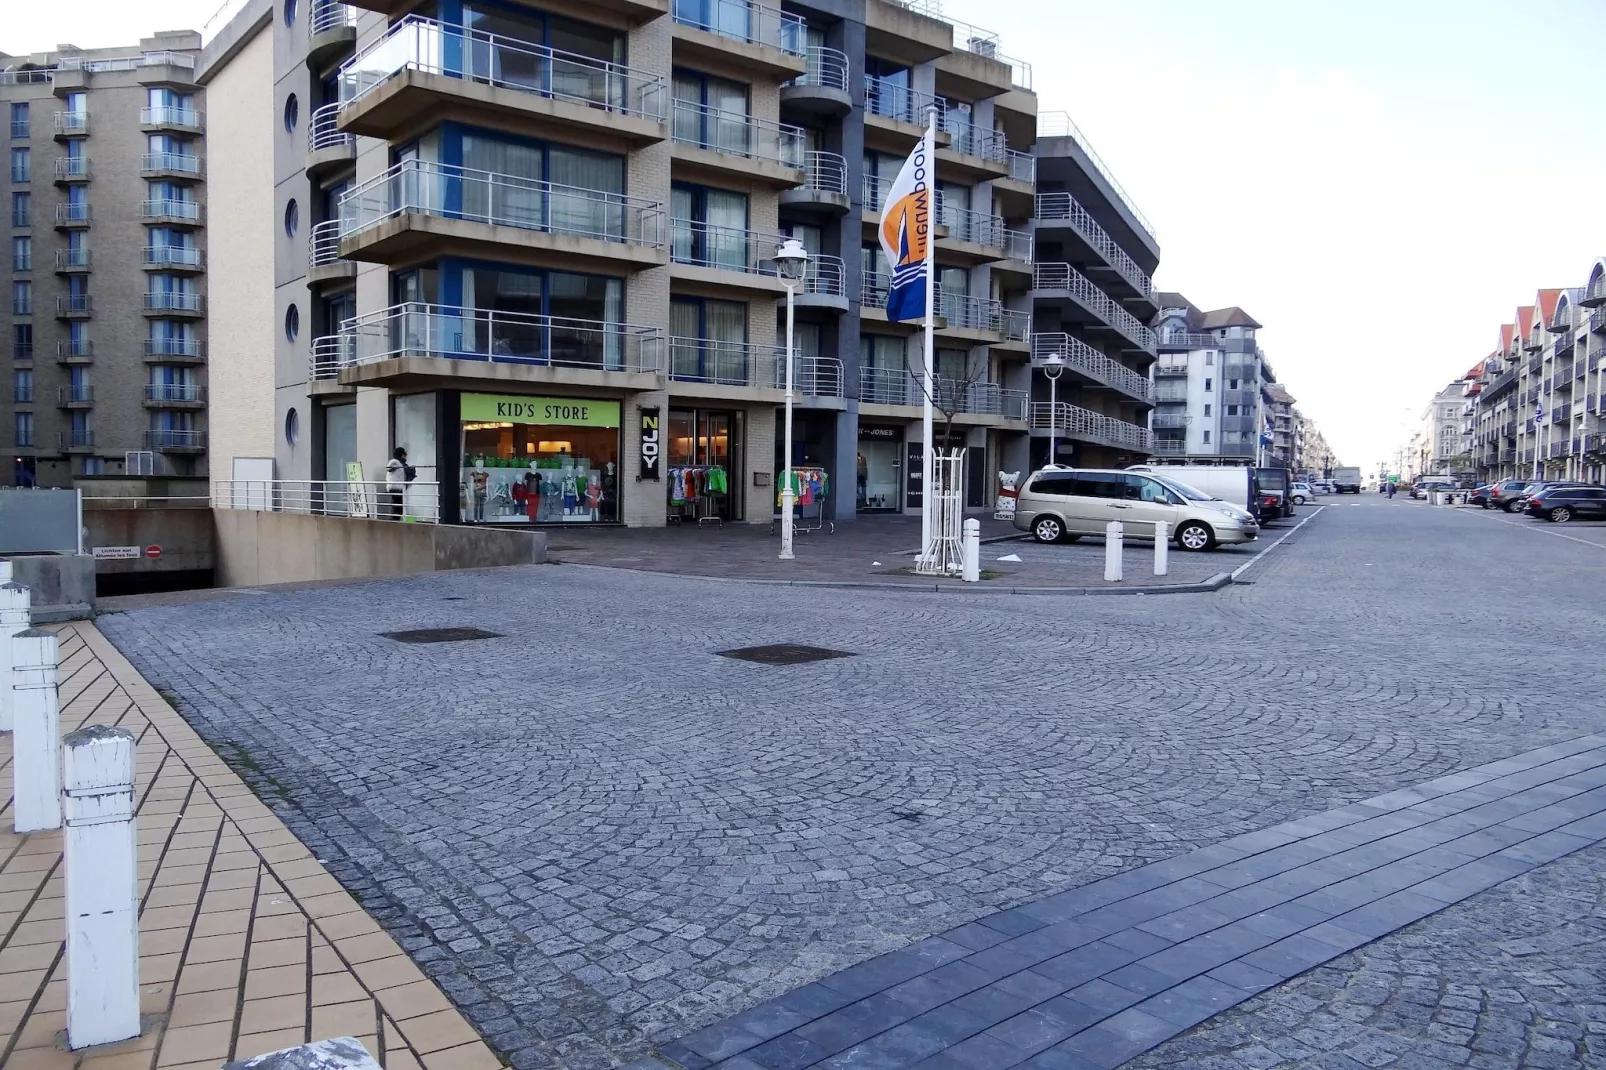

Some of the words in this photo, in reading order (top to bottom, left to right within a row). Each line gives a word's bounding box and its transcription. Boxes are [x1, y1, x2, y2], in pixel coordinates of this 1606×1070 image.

[497, 402, 535, 418] KID'S
[545, 405, 589, 420] STORE
[642, 416, 658, 469] NJOY
